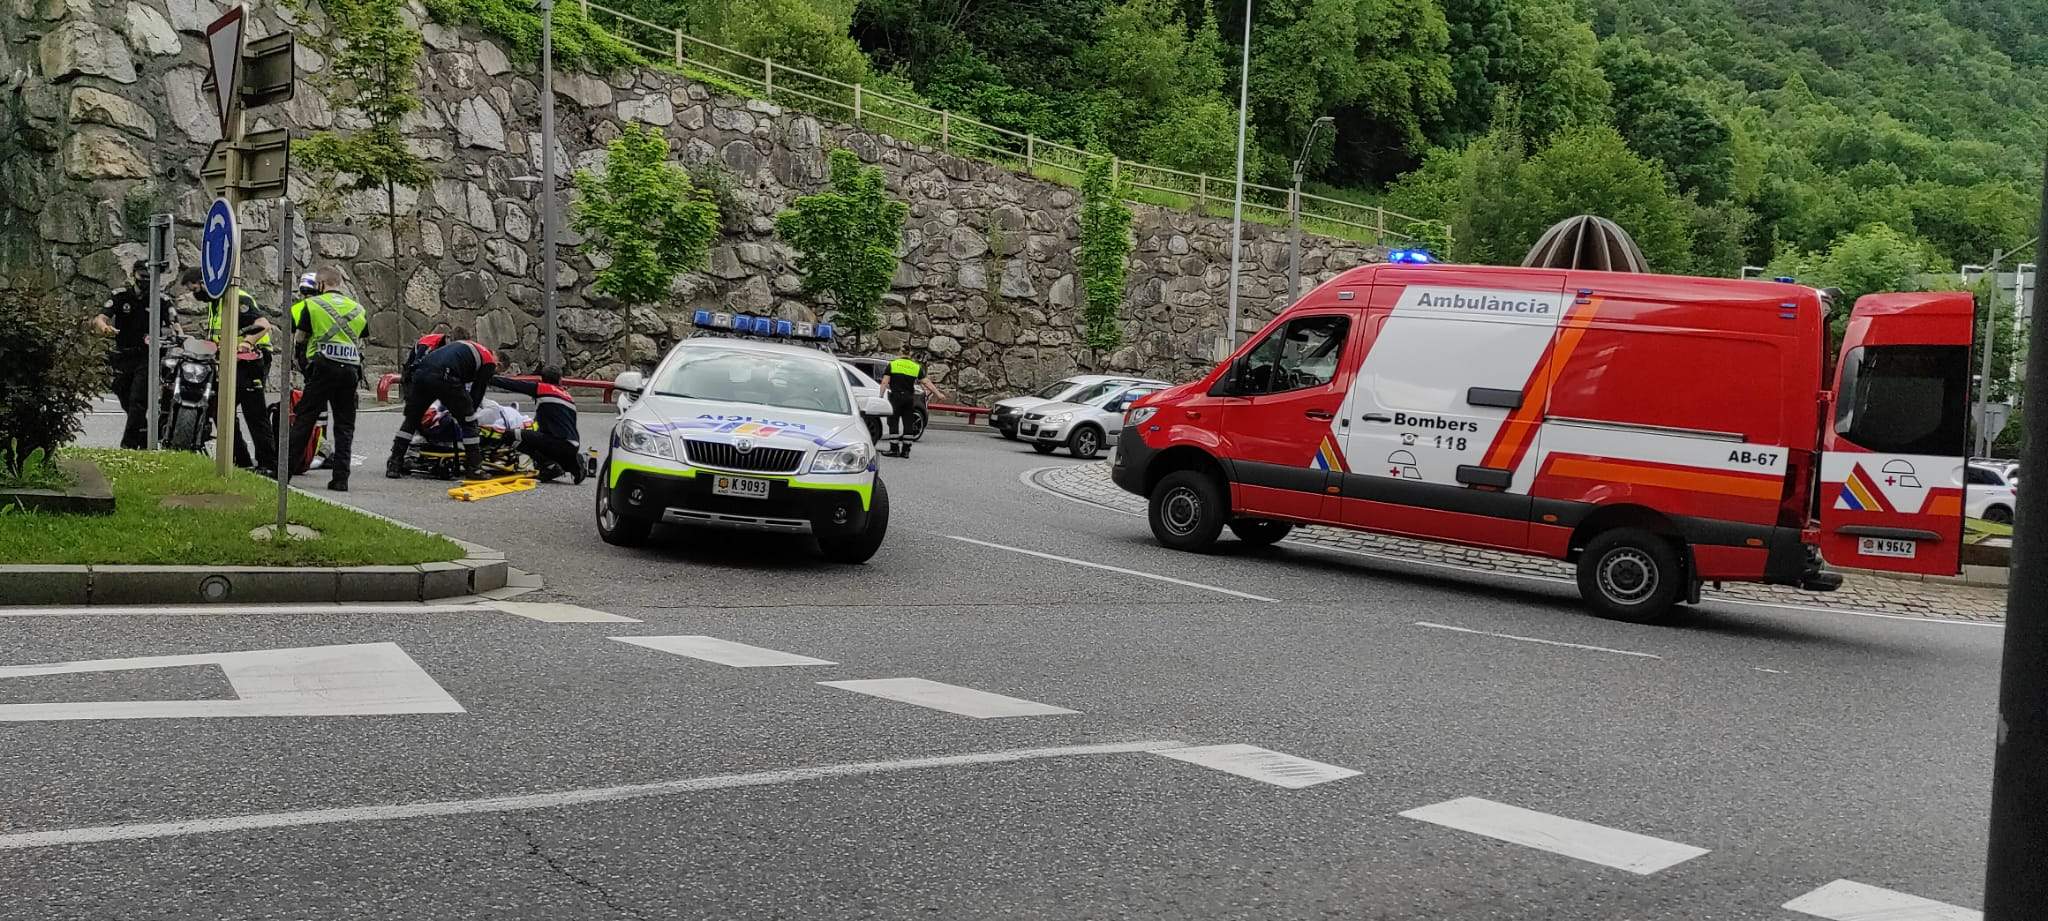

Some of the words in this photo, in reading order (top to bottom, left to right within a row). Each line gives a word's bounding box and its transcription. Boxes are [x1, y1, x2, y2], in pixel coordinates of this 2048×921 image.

[1417, 292, 1550, 314] Ambulància
[1394, 412, 1478, 433] Bombers
[1433, 435, 1468, 451] 118
[1728, 450, 1778, 466] AB-67
[731, 478, 739, 491] K
[740, 479, 767, 494] 9093
[1877, 540, 1885, 551] N
[1886, 541, 1912, 554] 9642
